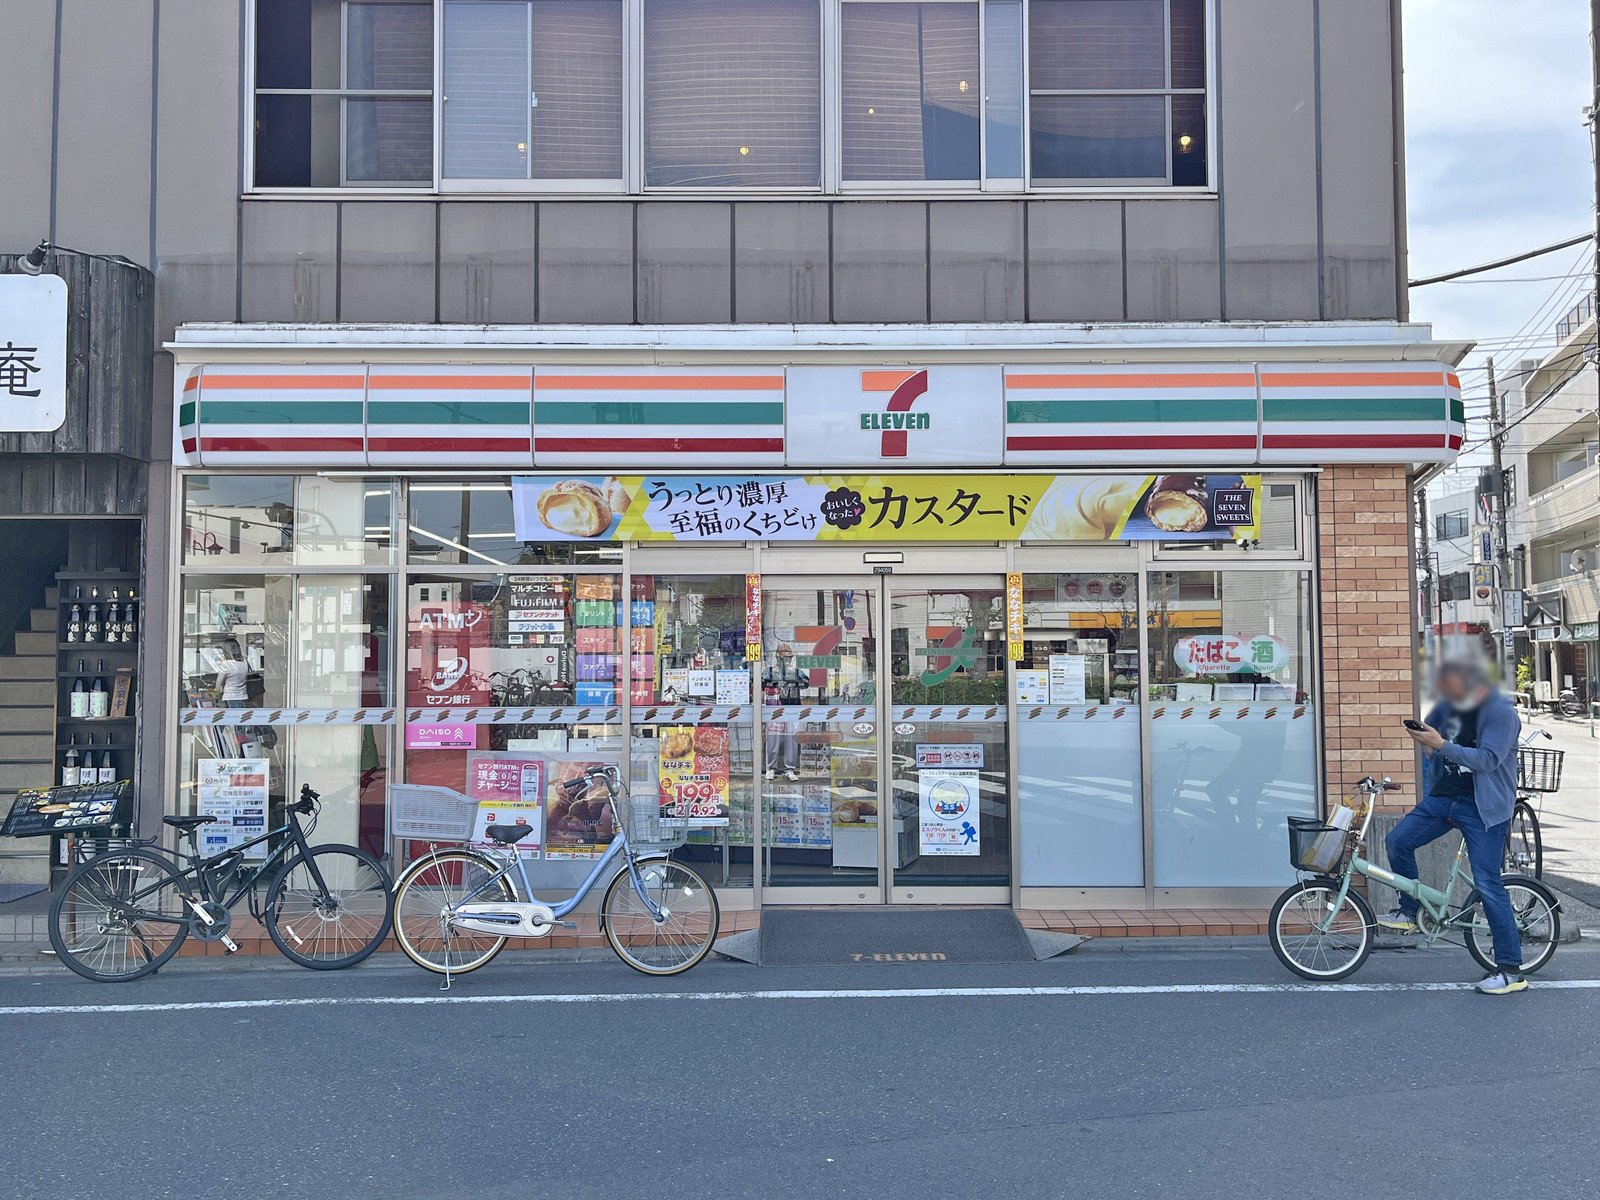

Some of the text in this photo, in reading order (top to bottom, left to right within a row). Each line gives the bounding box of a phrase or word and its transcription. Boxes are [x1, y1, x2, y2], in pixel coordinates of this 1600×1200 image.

[648, 481, 789, 511] うっとり濃厚
[826, 496, 859, 511] おいしく
[1224, 494, 1242, 502] THE
[828, 509, 854, 520] なった
[868, 486, 1032, 530] カスタード
[668, 507, 818, 537] 至福のくちどけ
[1216, 513, 1250, 521] SWEETS
[1009, 586, 1021, 634] ななチキ
[746, 644, 760, 660] 199
[1008, 643, 1023, 660] 199
[1188, 640, 1274, 663] たばこ 酒
[426, 695, 471, 704] セブン銀行
[662, 760, 692, 769] ななチキ
[477, 770, 499, 781] 現金
[477, 780, 510, 790] チャージ
